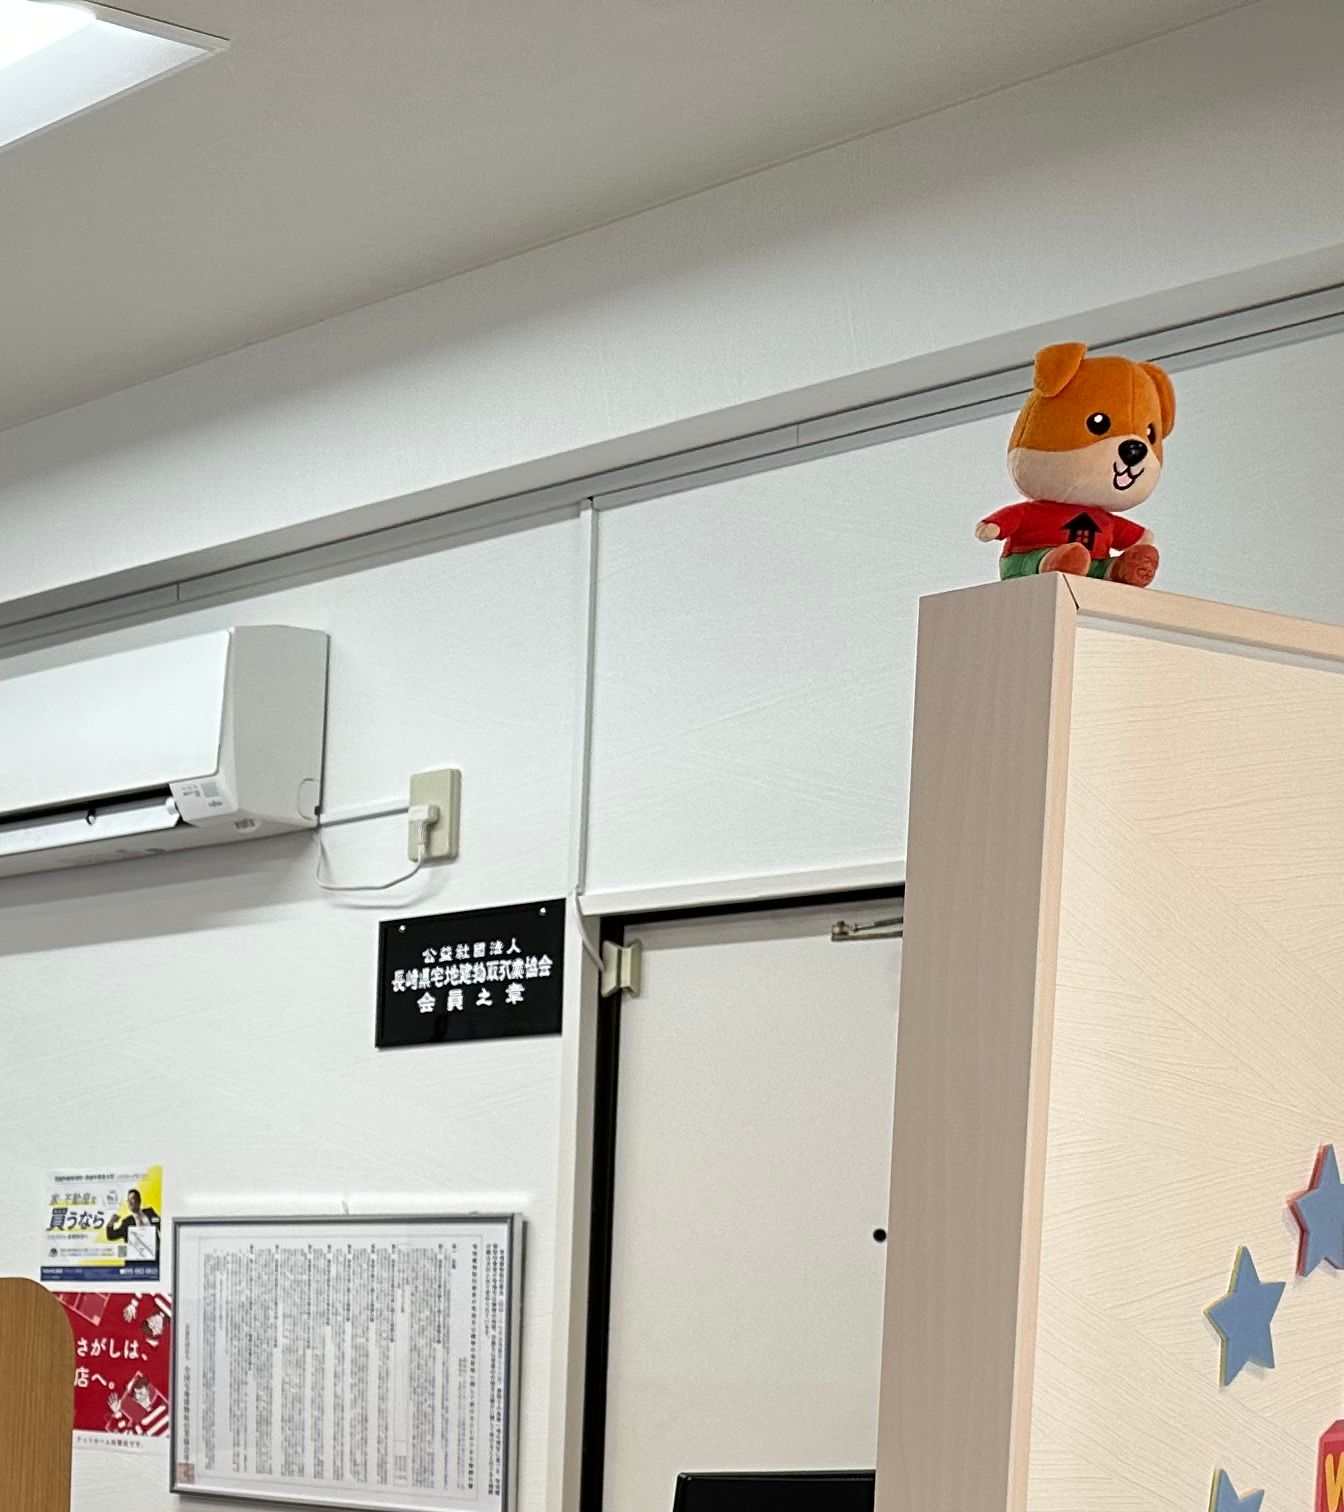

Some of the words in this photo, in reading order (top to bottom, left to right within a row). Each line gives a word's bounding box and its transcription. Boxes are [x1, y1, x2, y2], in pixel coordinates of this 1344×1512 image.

[422, 937, 521, 964] 公益社団法人
[46, 1207, 105, 1231] 買うなら
[77, 1337, 148, 1361] さがしは、
